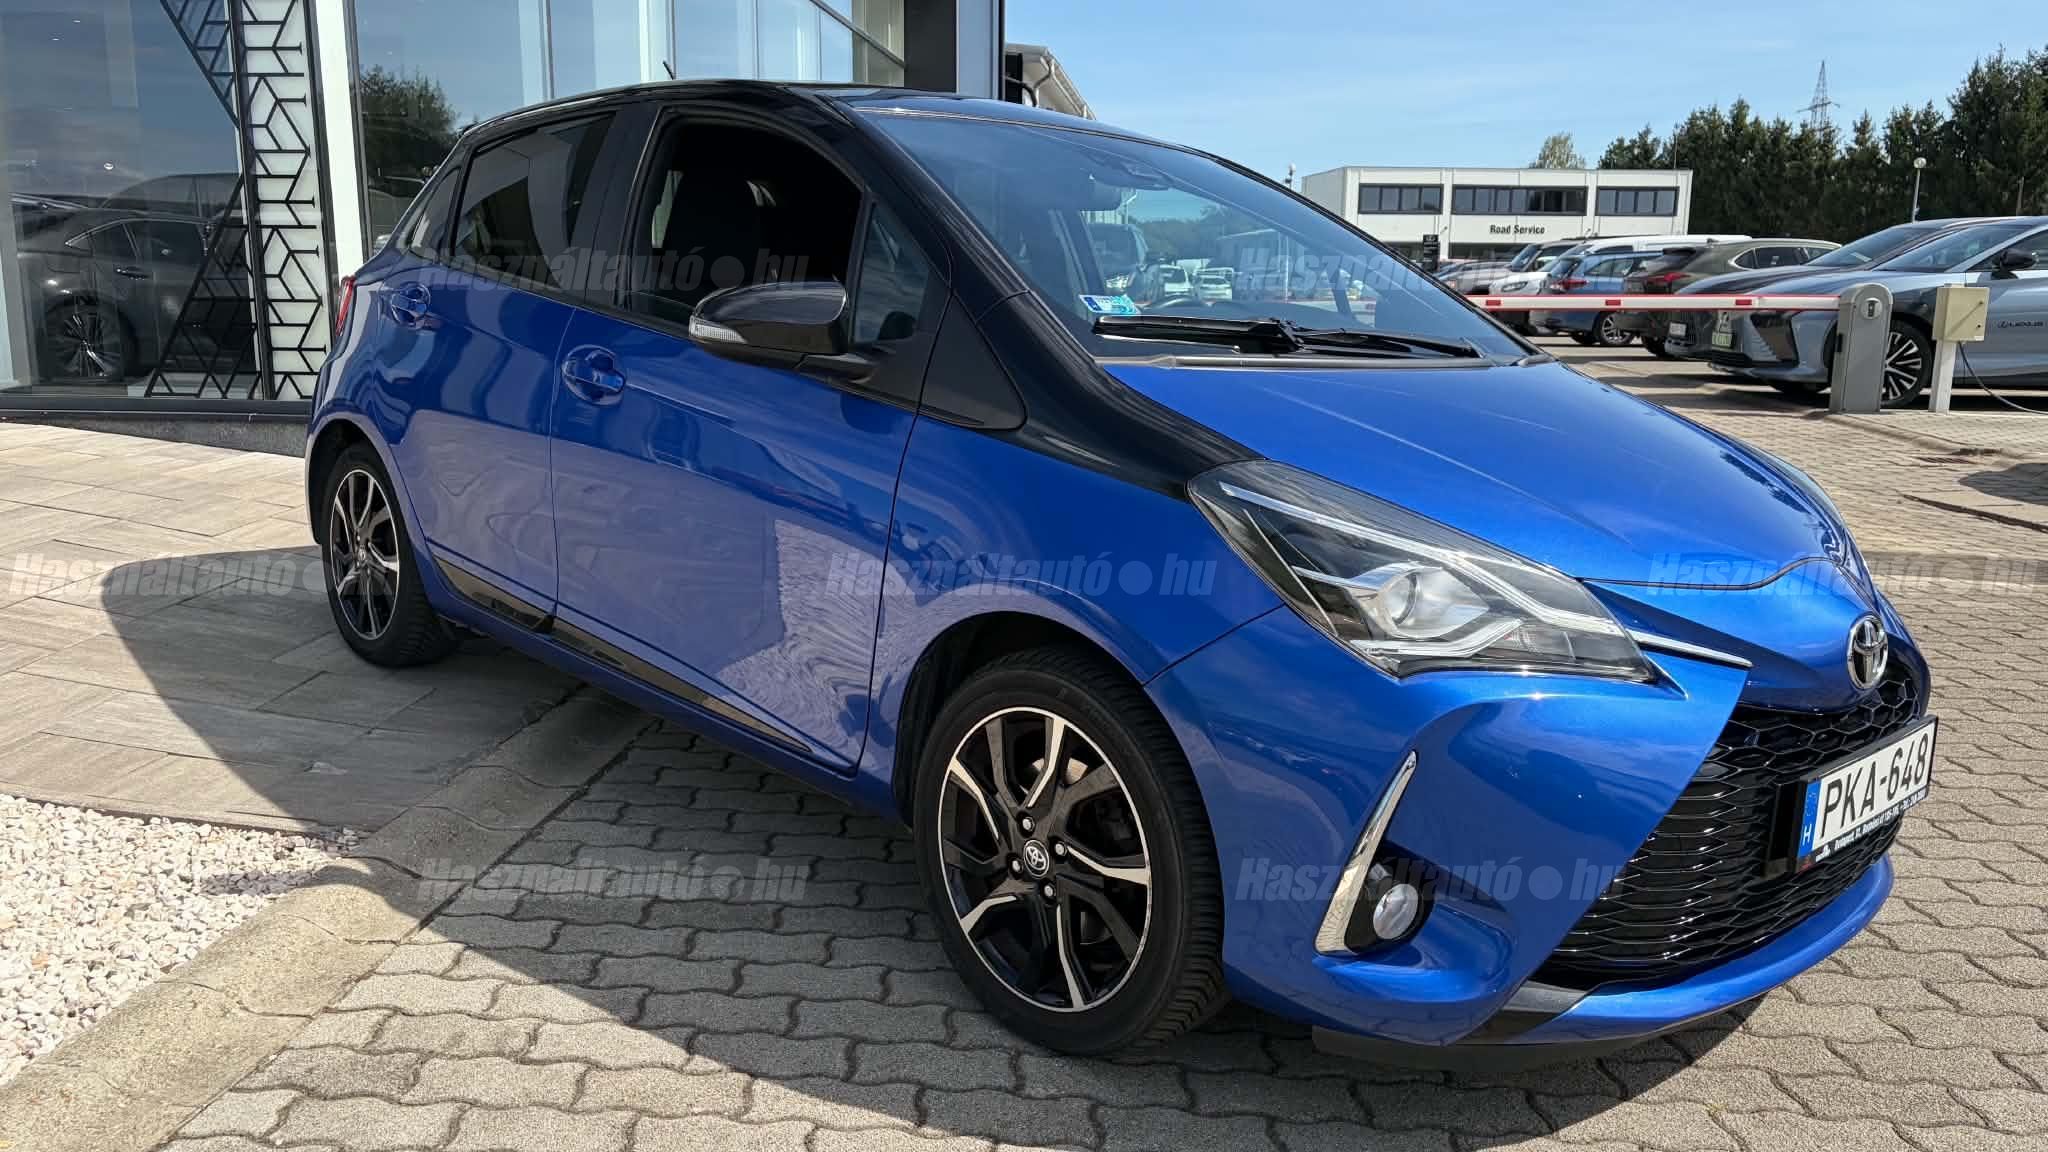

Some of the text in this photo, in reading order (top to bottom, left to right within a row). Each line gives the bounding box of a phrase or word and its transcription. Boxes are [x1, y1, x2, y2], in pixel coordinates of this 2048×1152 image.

[1490, 224, 1545, 234] Road Service
[1802, 823, 1812, 846] H
[1820, 732, 1929, 839] PKA-648
